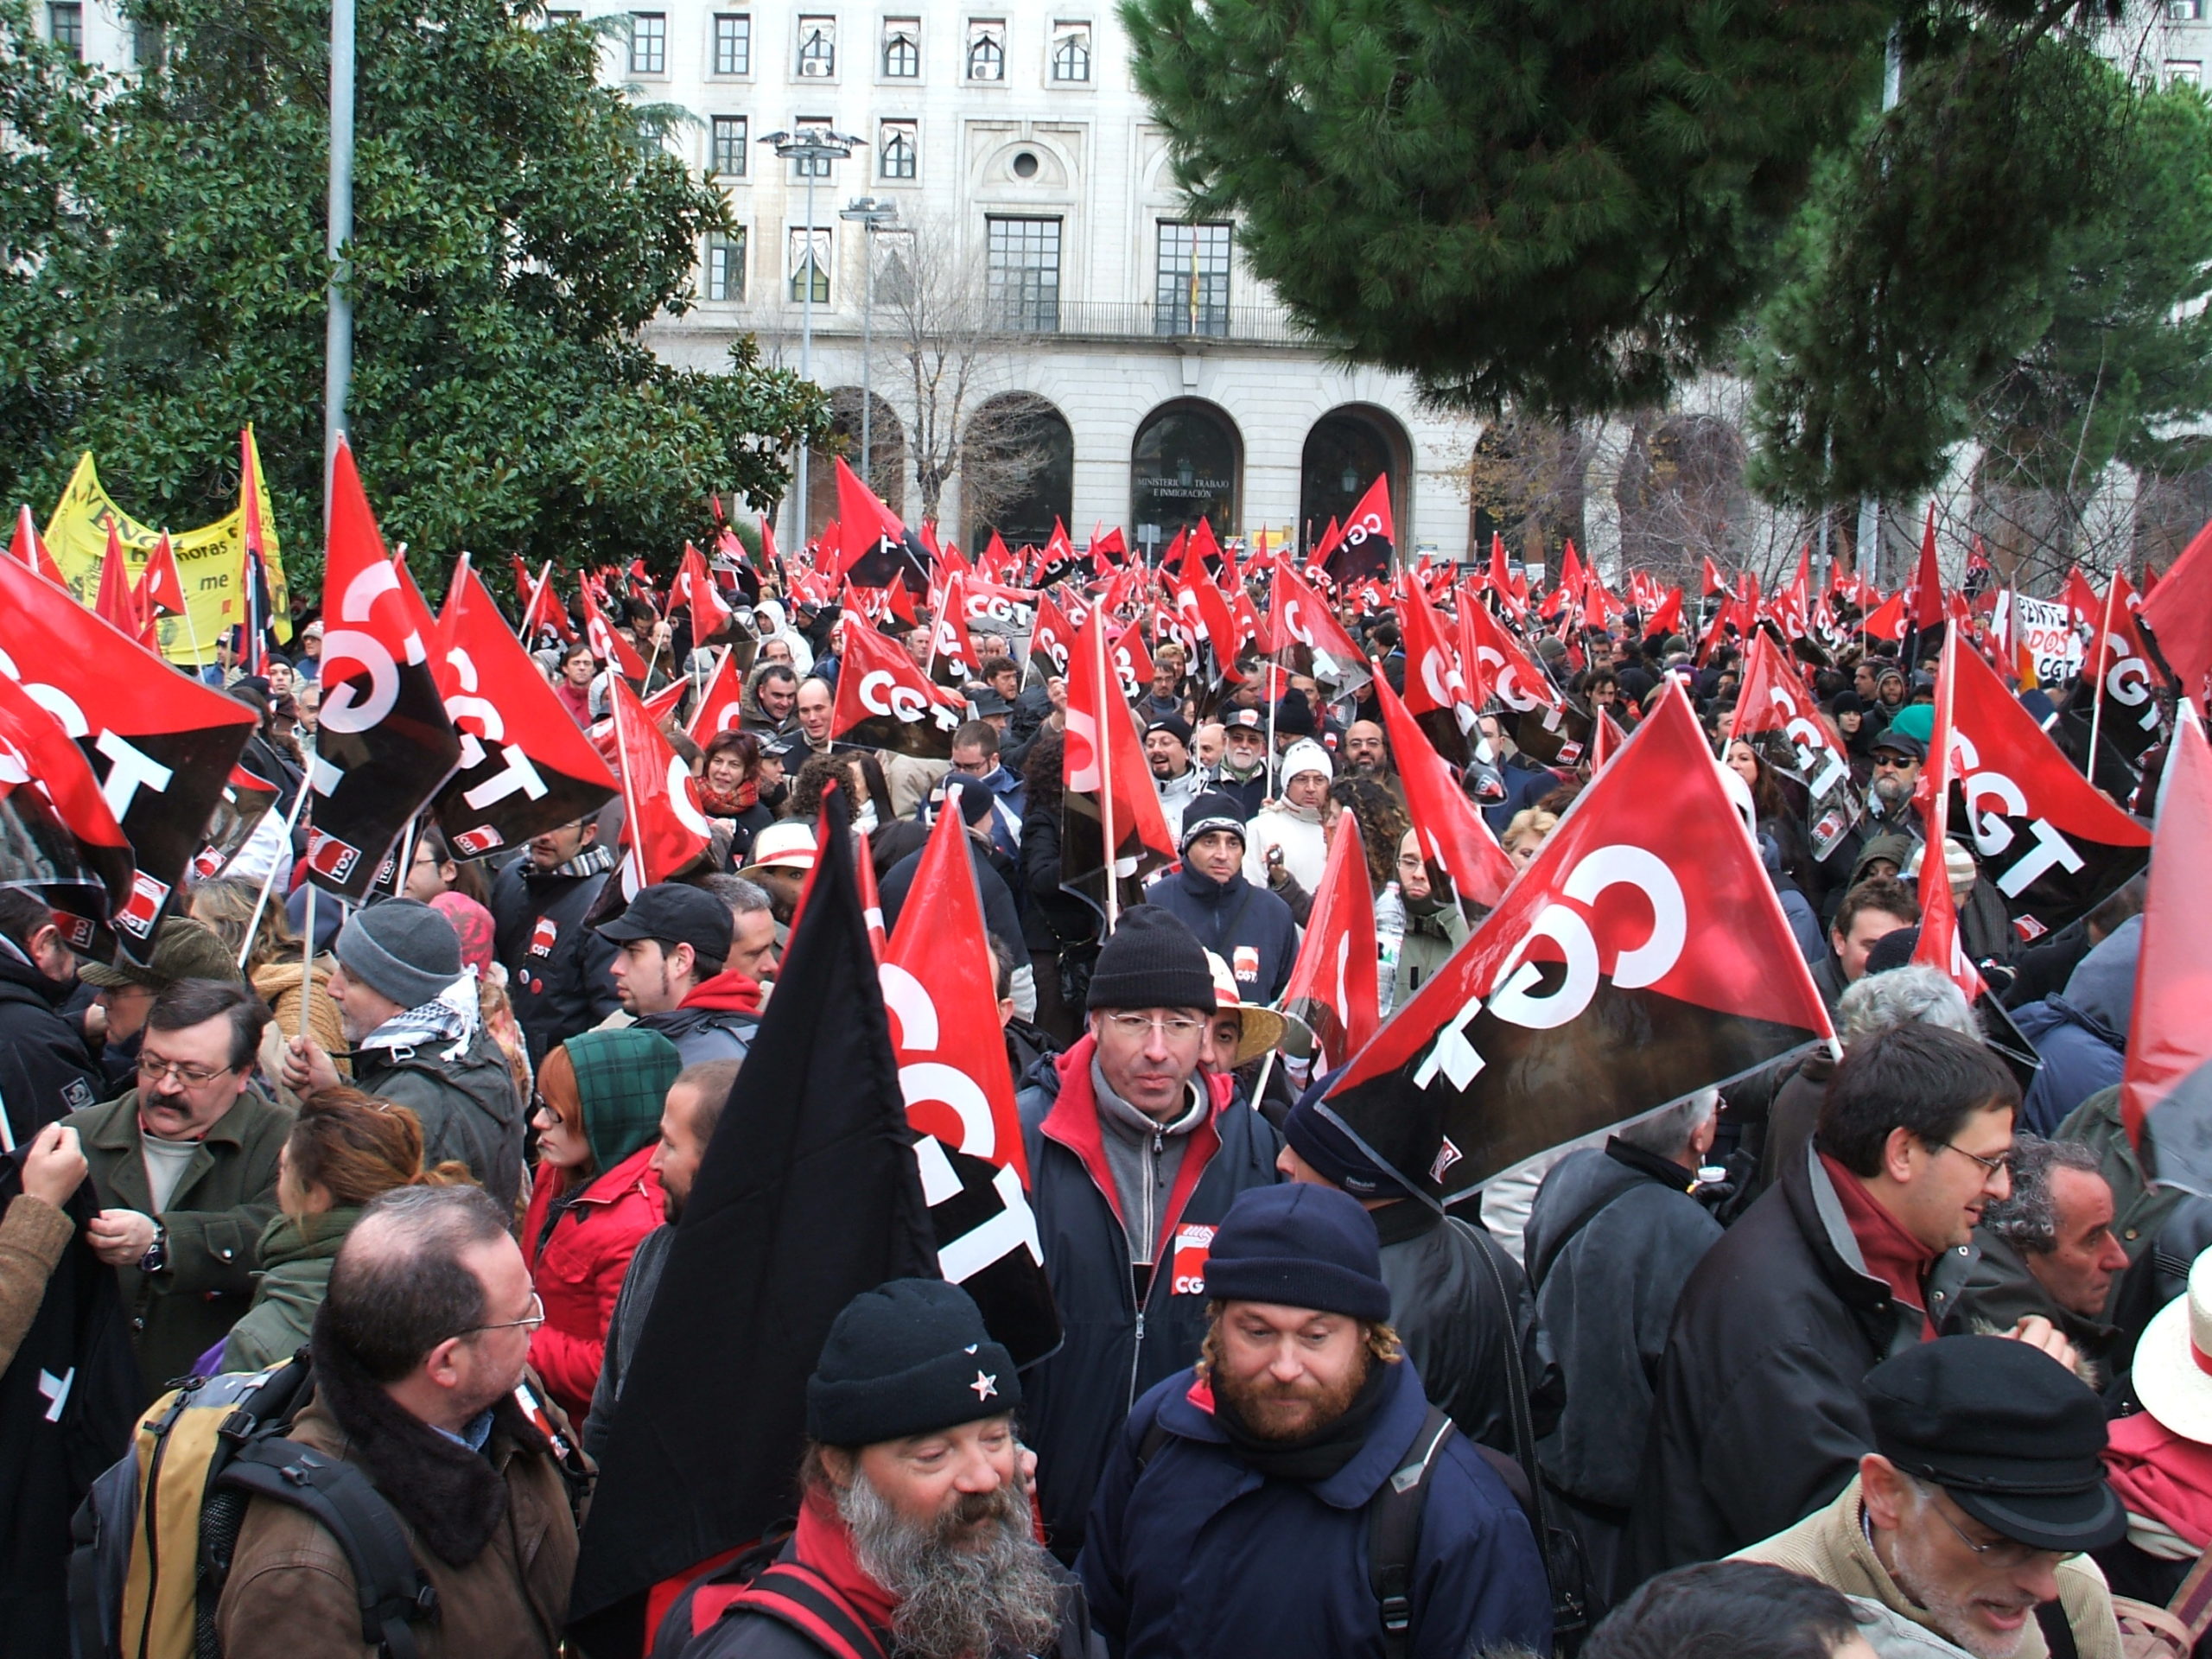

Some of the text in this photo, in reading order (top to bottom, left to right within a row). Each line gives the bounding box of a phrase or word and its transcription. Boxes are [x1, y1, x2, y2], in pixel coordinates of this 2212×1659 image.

[1154, 488, 1159, 497] E
[1195, 479, 1230, 488] TRABAJO
[200, 575, 228, 591] me
[966, 594, 1032, 626] CGT
[2039, 658, 2075, 679] CGT
[859, 670, 960, 733] CGT
[1770, 686, 1852, 800] CGT
[531, 943, 551, 958] CGT
